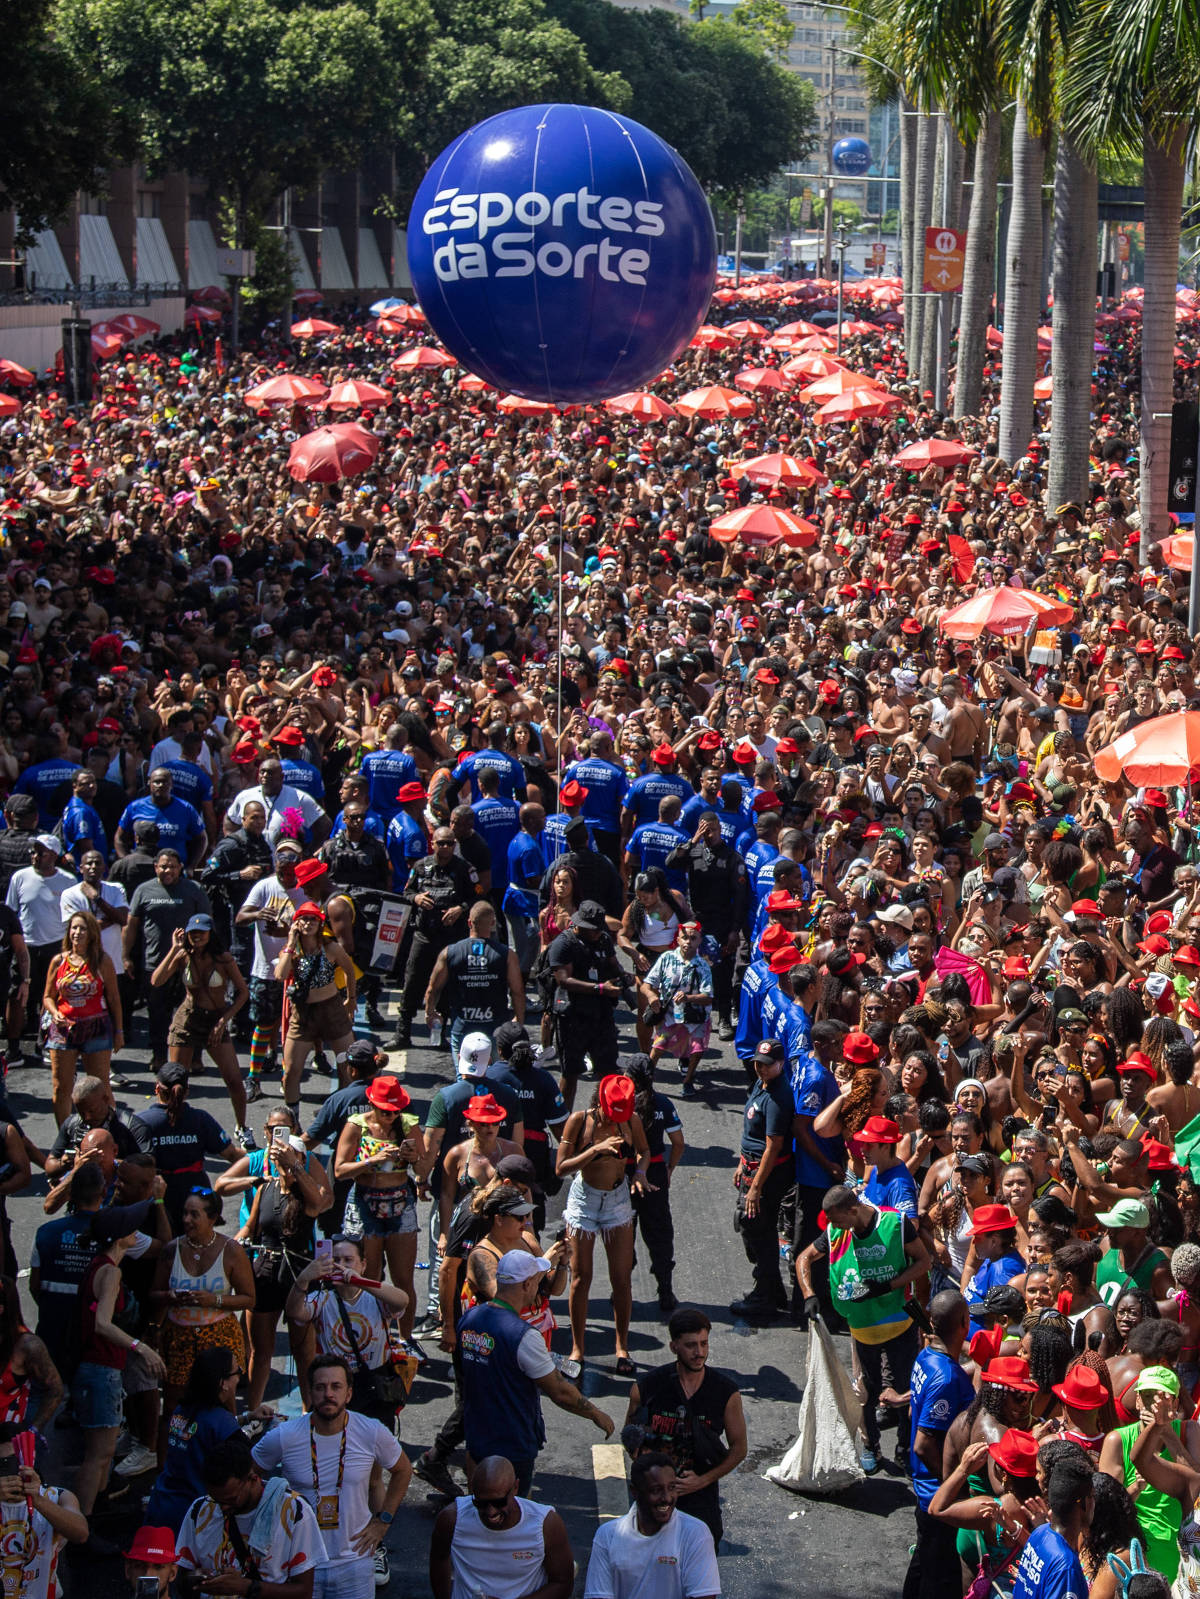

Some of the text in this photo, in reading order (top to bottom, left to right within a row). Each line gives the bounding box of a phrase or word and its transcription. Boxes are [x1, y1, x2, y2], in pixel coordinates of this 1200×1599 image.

[423, 186, 665, 240] Esportes
[434, 232, 650, 285] da Sorte
[38, 768, 76, 777] CONTROL
[577, 766, 613, 775] CONTROLE
[645, 782, 683, 790] CONTROLE
[643, 831, 679, 842] CONTROLE
[462, 1007, 493, 1020] 1746
[160, 1134, 198, 1145] BRIGADA
[861, 1265, 894, 1277] COLETA
